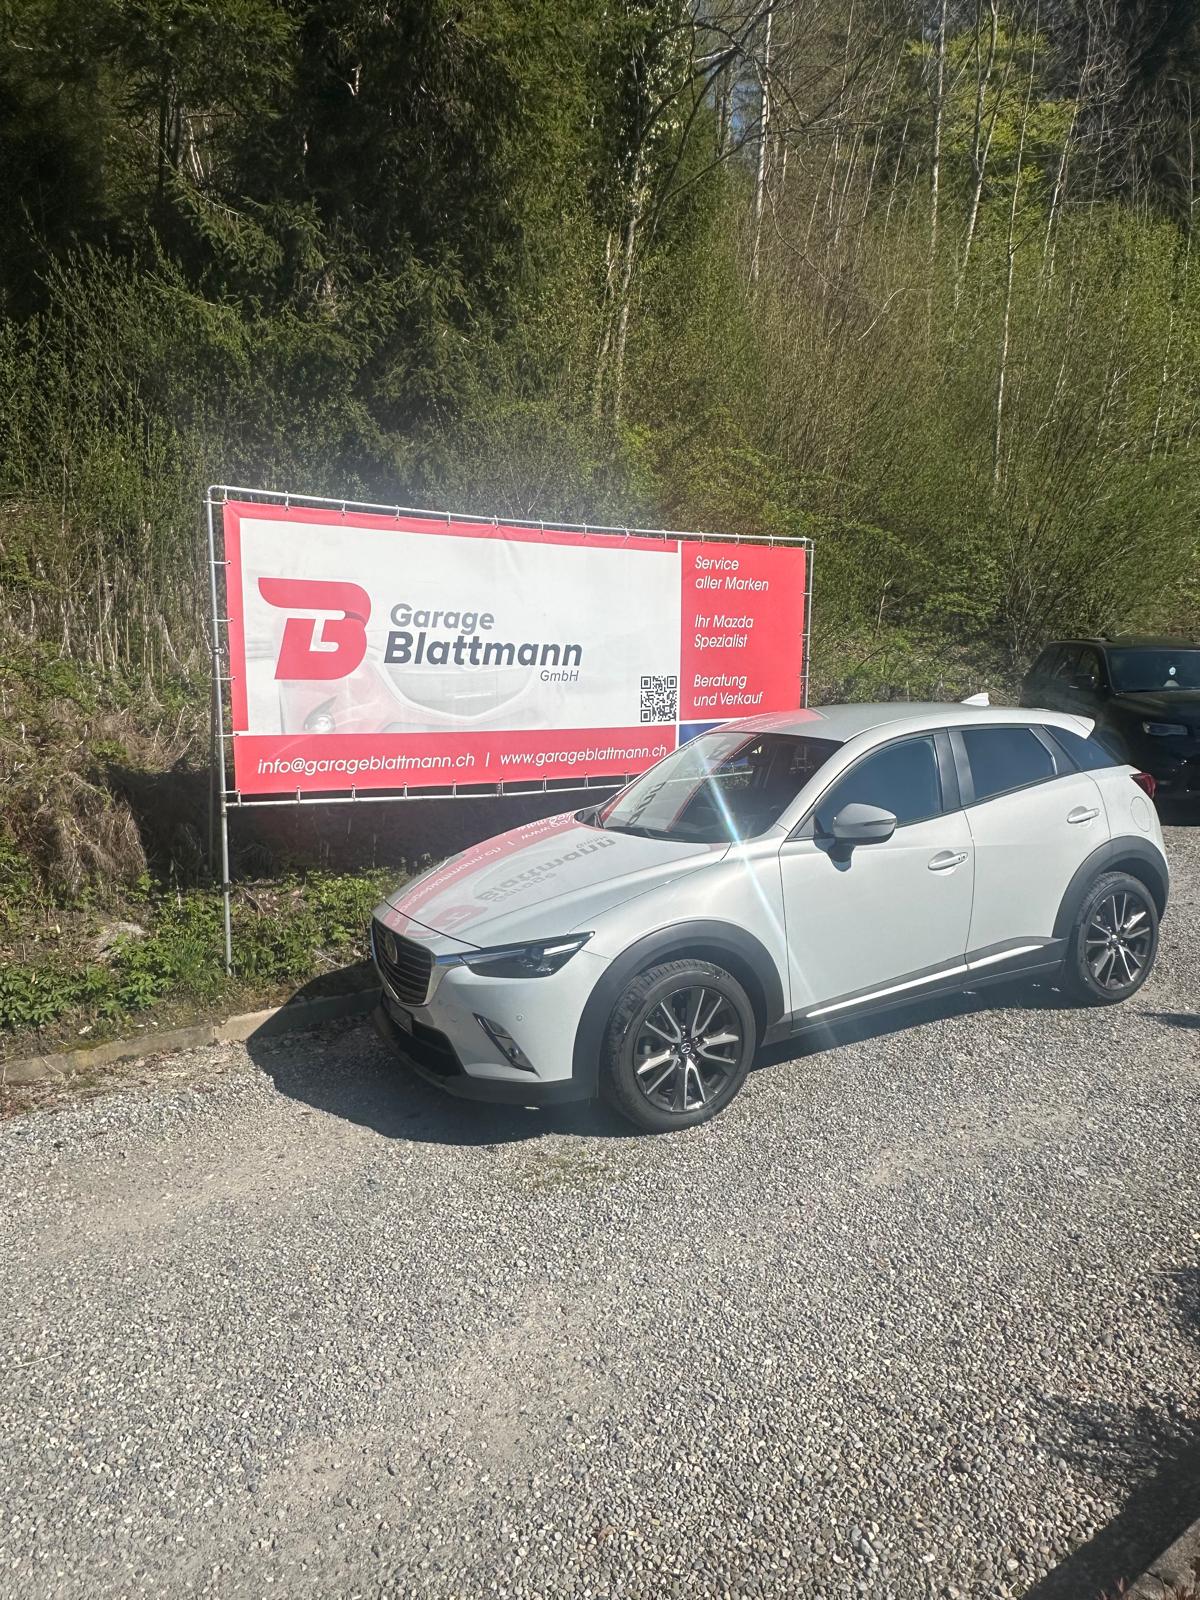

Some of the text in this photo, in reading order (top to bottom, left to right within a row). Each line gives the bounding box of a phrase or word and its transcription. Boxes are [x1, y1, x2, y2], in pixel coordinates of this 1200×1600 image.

[694, 555, 739, 570] Service
[695, 576, 769, 591] aller Marken
[390, 603, 495, 636] Garage
[694, 614, 754, 628] Ihr Mazda
[383, 630, 583, 666] Blattmann
[694, 634, 748, 650] Spezialist
[539, 669, 580, 682] GmbH
[693, 674, 747, 689] Beratung
[693, 691, 764, 706] und Verkauf
[257, 752, 476, 776] info@garageblattmann.ch
[500, 744, 667, 766] www.garageblattmann.ch
